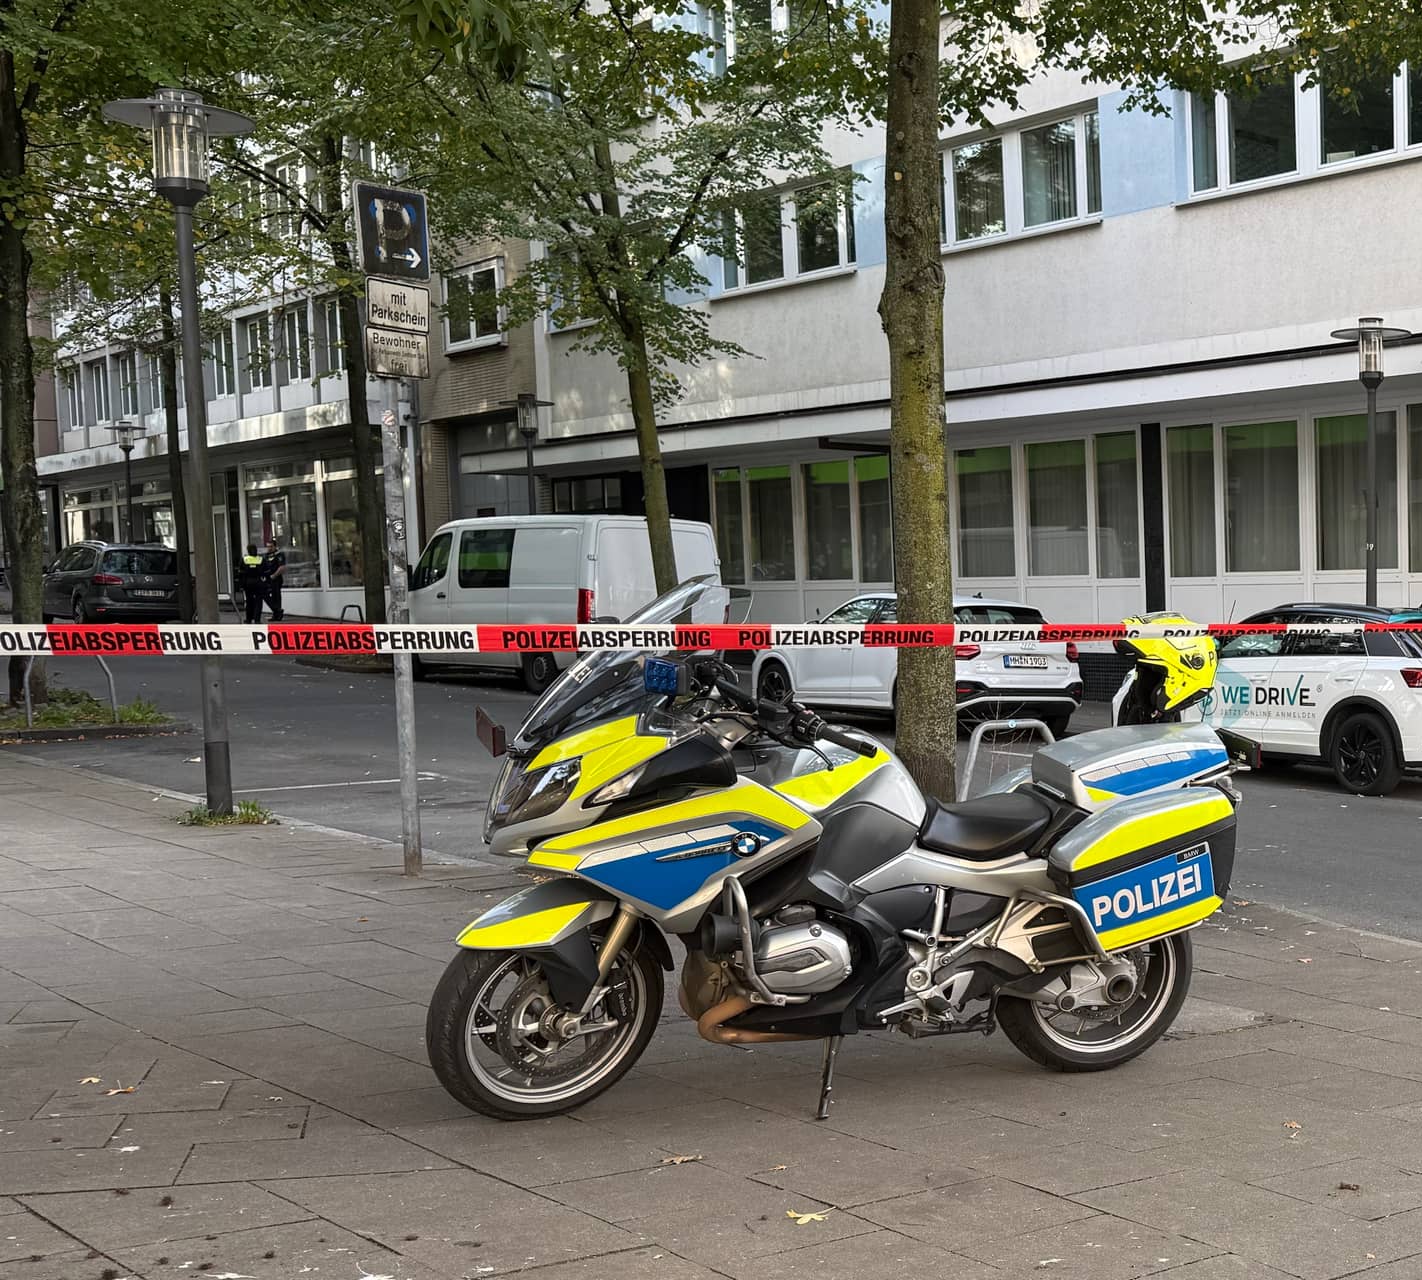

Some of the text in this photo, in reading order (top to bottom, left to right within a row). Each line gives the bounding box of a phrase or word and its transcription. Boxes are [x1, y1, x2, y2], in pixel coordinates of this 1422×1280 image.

[391, 292, 407, 306] mit
[371, 304, 426, 327] Parkschein
[373, 332, 421, 350] Bewohner
[0, 631, 222, 651] OLIZEIABSPERRUNG
[253, 630, 474, 650] POLIZEIABSPERRUNG
[503, 630, 711, 649] POLIZEIABSPERRUNG
[739, 630, 934, 645] POLIZEIABSPERRUNG
[1221, 675, 1316, 707] WE DRIVE
[1244, 710, 1272, 718] ONLINE
[1183, 848, 1200, 860] BMW
[1092, 862, 1202, 927] POLIZEI
